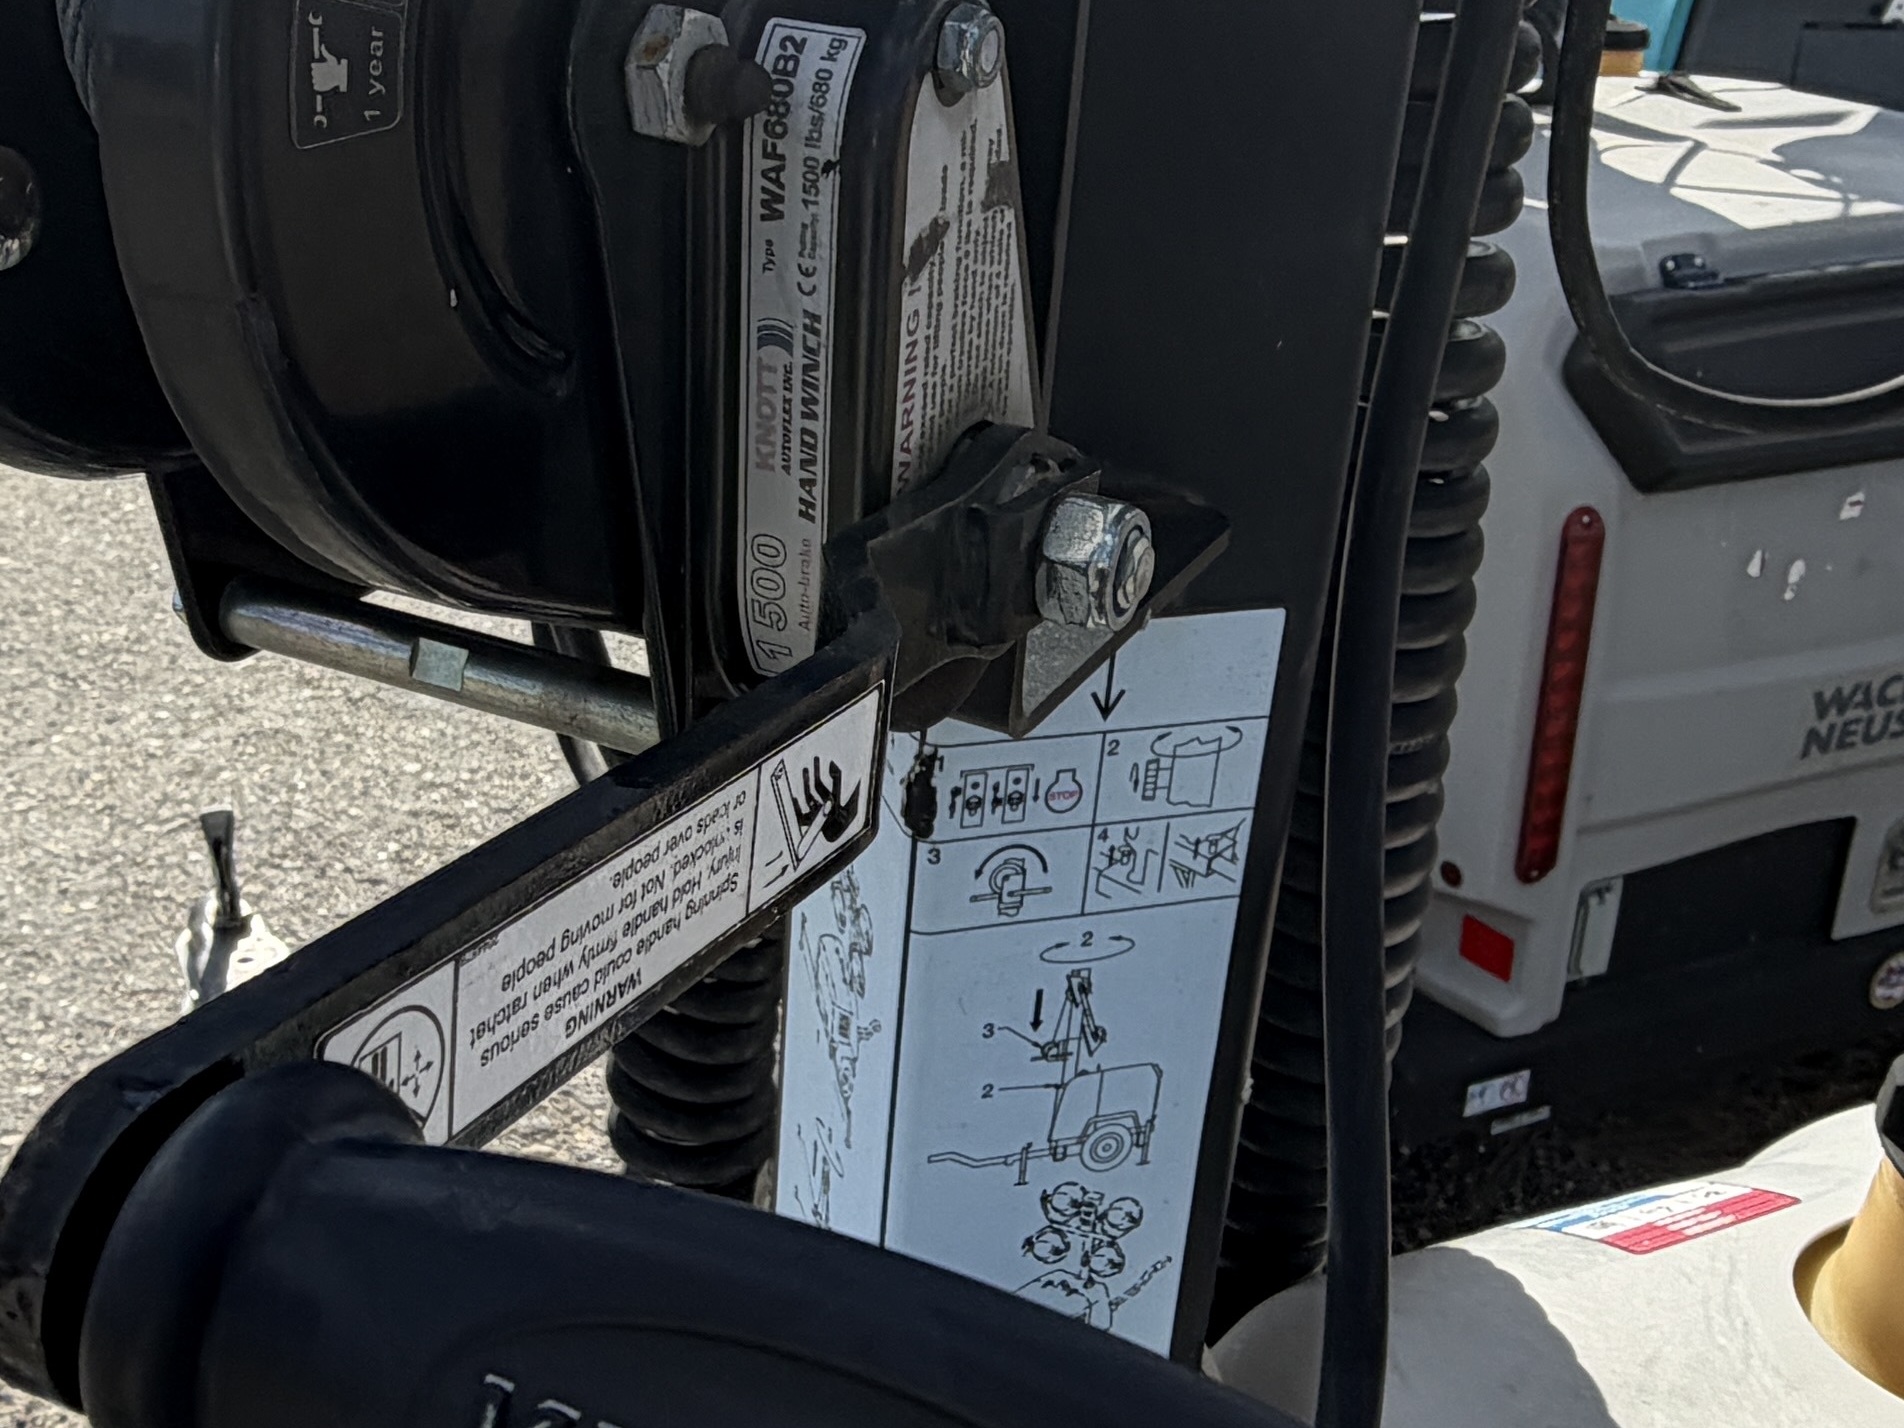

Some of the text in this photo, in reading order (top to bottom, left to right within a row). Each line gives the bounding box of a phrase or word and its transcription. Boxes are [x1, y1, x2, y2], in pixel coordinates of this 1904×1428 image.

[365, 25, 388, 97] year
[760, 35, 806, 221] WAF680B2
[801, 37, 849, 213] 1500 lbs/680 kg
[762, 239, 776, 274] Type
[756, 358, 777, 471] KNOTT
[781, 361, 793, 476] AUTOFLEX INC.
[798, 309, 821, 523] HAND WINCH
[797, 538, 811, 631] Auto-brake
[1106, 738, 1121, 757] 2
[732, 790, 747, 811] or
[1046, 789, 1080, 802] STOP
[663, 825, 693, 857] over
[733, 817, 744, 839] is
[1097, 827, 1110, 843] 4
[609, 842, 661, 889] people.
[926, 847, 942, 865] 3
[617, 889, 638, 915] for
[640, 869, 666, 902] Not
[671, 870, 703, 909] Hold
[560, 903, 615, 953] moving
[622, 895, 669, 938] handle
[578, 930, 618, 970] firmly
[1080, 930, 1094, 947] 2
[480, 872, 739, 1067] Spinning handle could cause serious
[501, 940, 556, 992] people
[532, 960, 574, 1001] when
[469, 992, 528, 1049] ratchet
[565, 968, 642, 1039] WARNING
[982, 1022, 995, 1039] 3
[981, 1083, 994, 1099] 2
